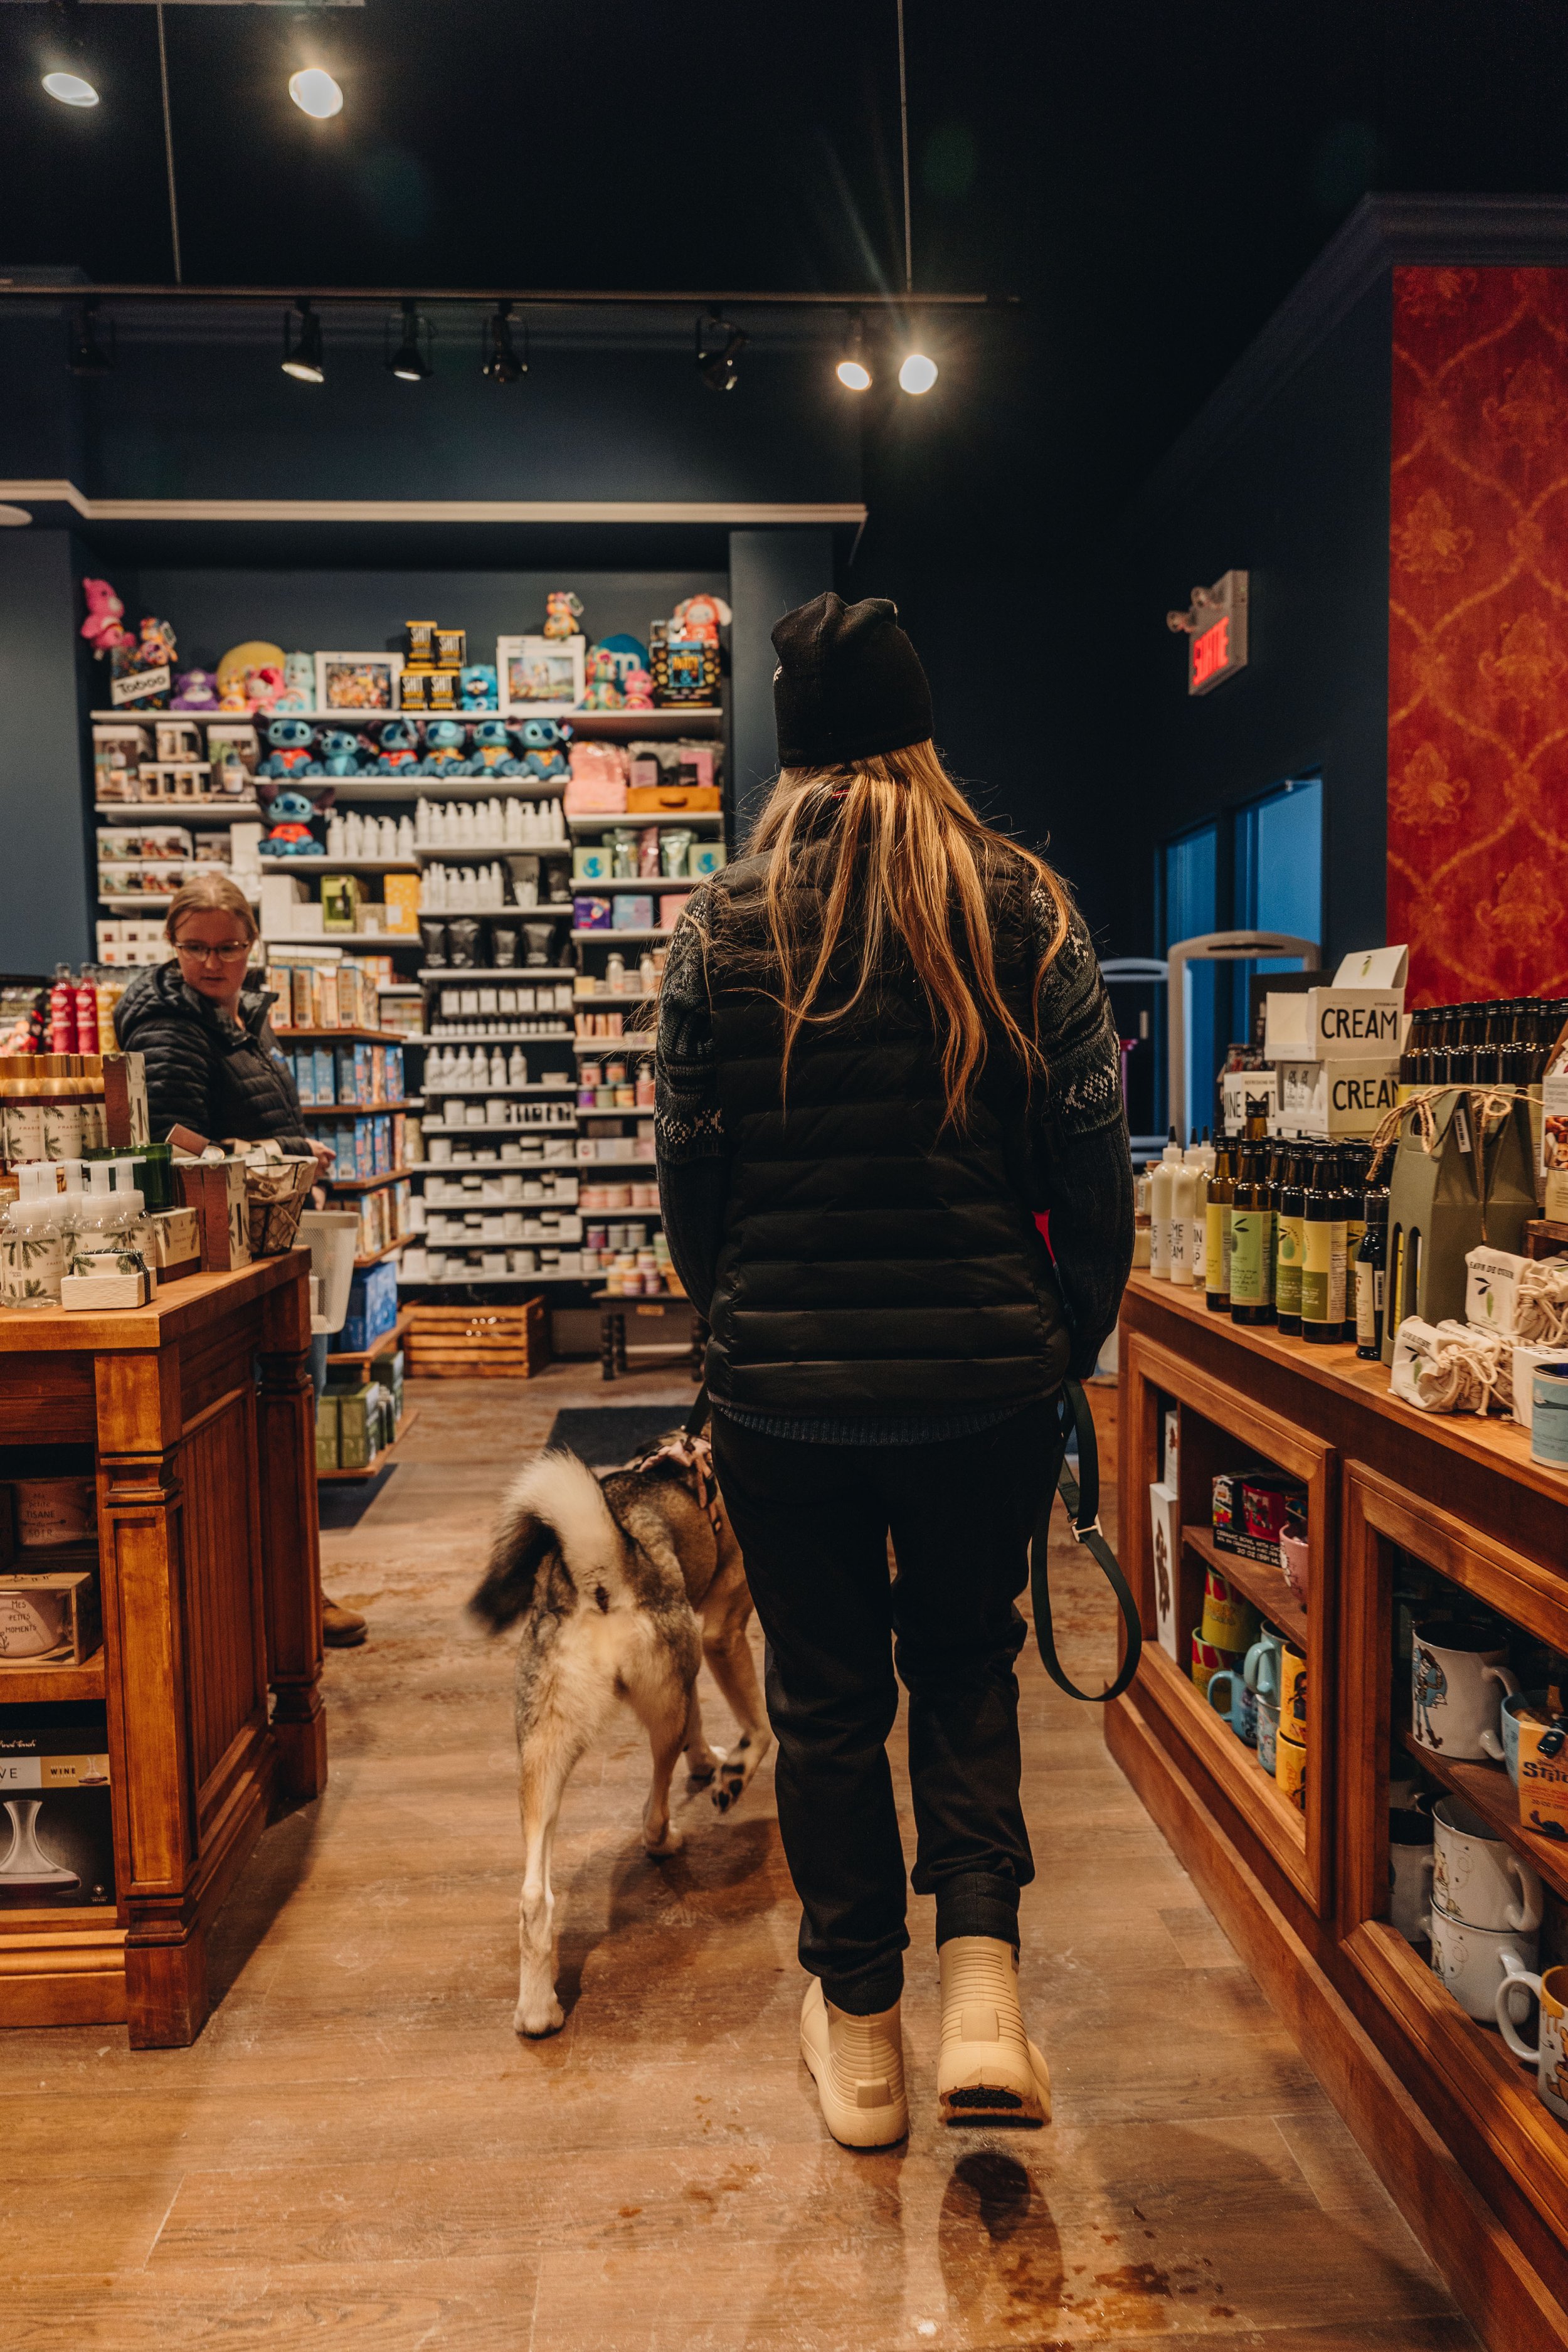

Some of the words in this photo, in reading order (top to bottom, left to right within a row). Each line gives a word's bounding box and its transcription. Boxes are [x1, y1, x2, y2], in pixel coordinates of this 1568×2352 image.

[1321, 1008, 1397, 1040] CREAM
[26, 1510, 55, 1518] TISANE
[1239, 1536, 1255, 1545] BOWL
[1236, 1547, 1246, 1555] 20
[6, 1624, 36, 1633] MOMENTS
